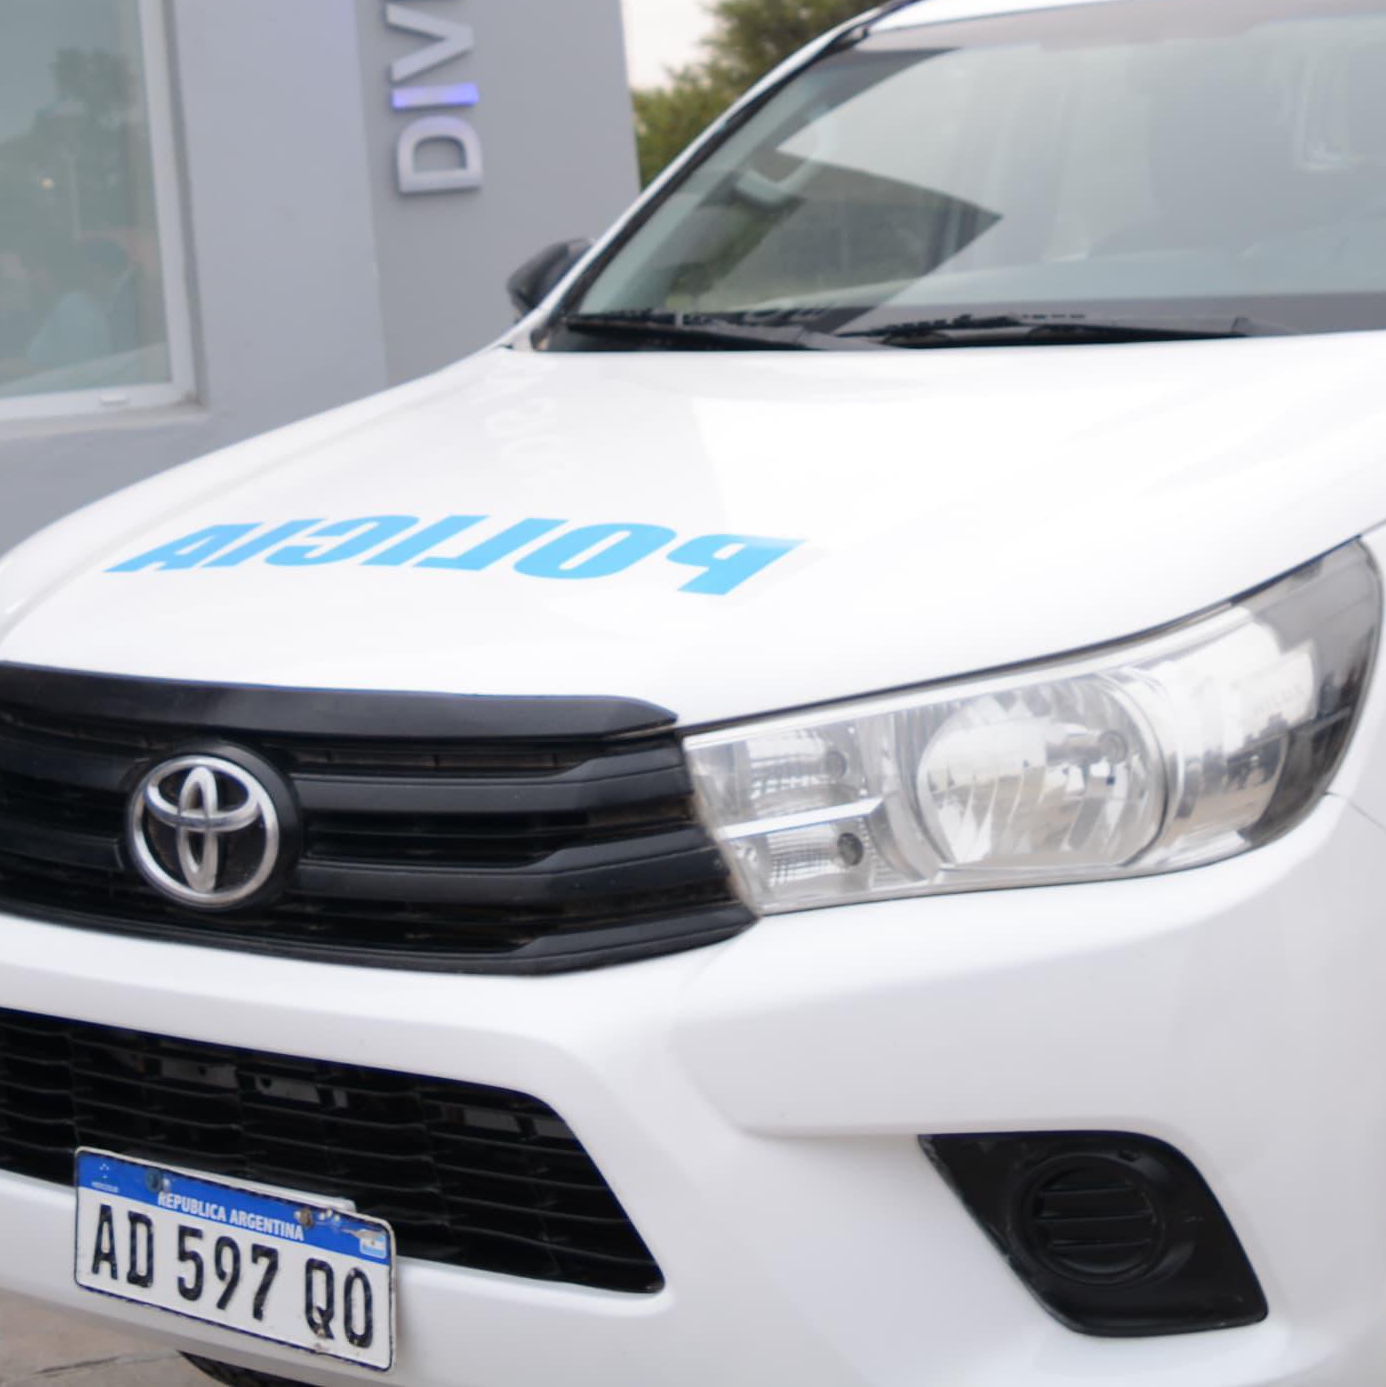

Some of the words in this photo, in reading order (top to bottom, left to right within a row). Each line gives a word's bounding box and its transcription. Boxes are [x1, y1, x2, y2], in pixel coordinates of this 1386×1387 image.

[91, 1203, 155, 1289] AD
[177, 1224, 280, 1322] 597
[229, 1208, 305, 1242] ARGENTINA
